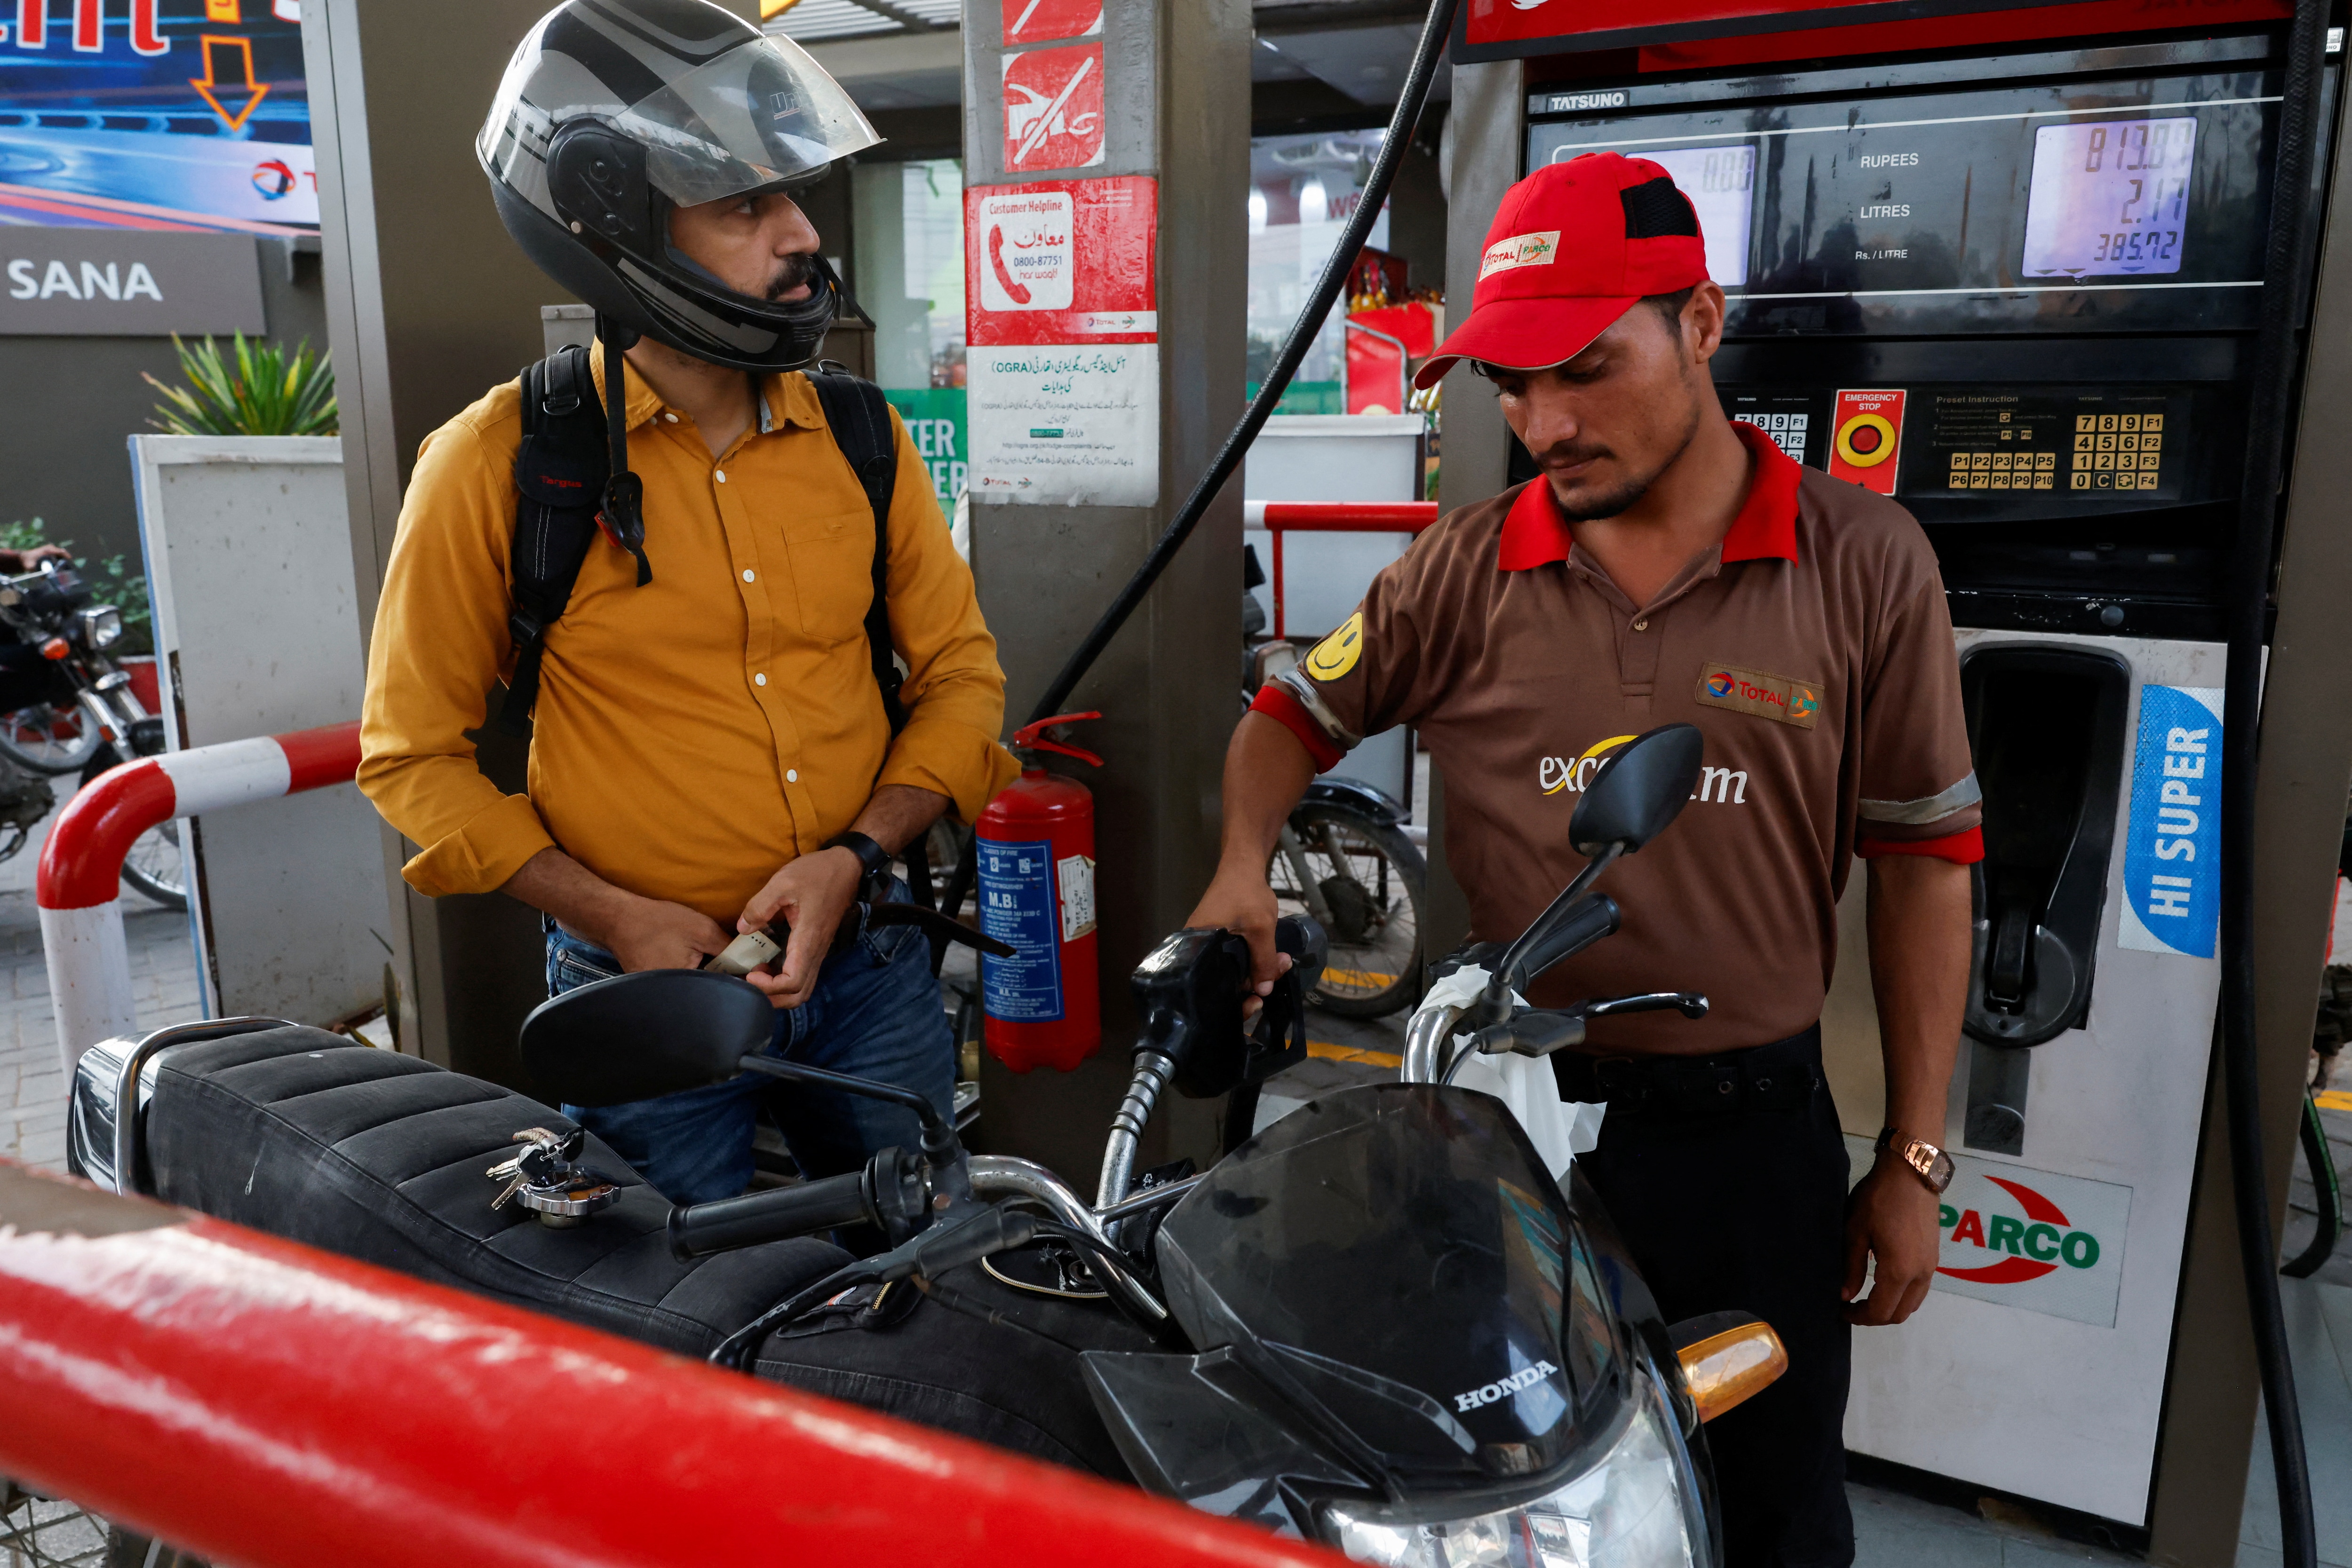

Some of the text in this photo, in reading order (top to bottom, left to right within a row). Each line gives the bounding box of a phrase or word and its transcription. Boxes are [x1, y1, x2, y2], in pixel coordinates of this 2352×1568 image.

[1551, 92, 1624, 110] TATSUNO
[1861, 153, 1919, 168] RUPEES
[989, 200, 1062, 215] Customer Helpline
[1860, 204, 1910, 219] LITRES
[1013, 224, 1064, 249] معاون
[2094, 231, 2177, 261] 385.72
[1014, 256, 1063, 267] 0800-87751
[1490, 244, 1551, 265] TOTAL PARCO
[1855, 251, 1870, 260] Rs.
[1879, 249, 1908, 259] LITRE
[7, 259, 164, 302] SANA
[991, 359, 1033, 374] (OGRA)
[1757, 416, 1765, 428] 8
[1776, 416, 1784, 428] 9
[2082, 417, 2160, 430] 7 8 9 F1
[1774, 435, 1782, 446] 6
[2079, 436, 2159, 449] 4 5 6 F2
[1954, 457, 2053, 466] P1 P2 P3 P4 P5
[2080, 455, 2157, 468] 1 2 3 F3
[539, 475, 582, 488] Targus
[1951, 475, 2053, 485] P6 P7 P8 P9 P10
[2076, 474, 2155, 487] 0 C F4
[1739, 681, 1818, 711] TOTAL PARCO
[2149, 727, 2209, 918] HI SUPER
[1454, 1360, 1558, 1413] HONDA
